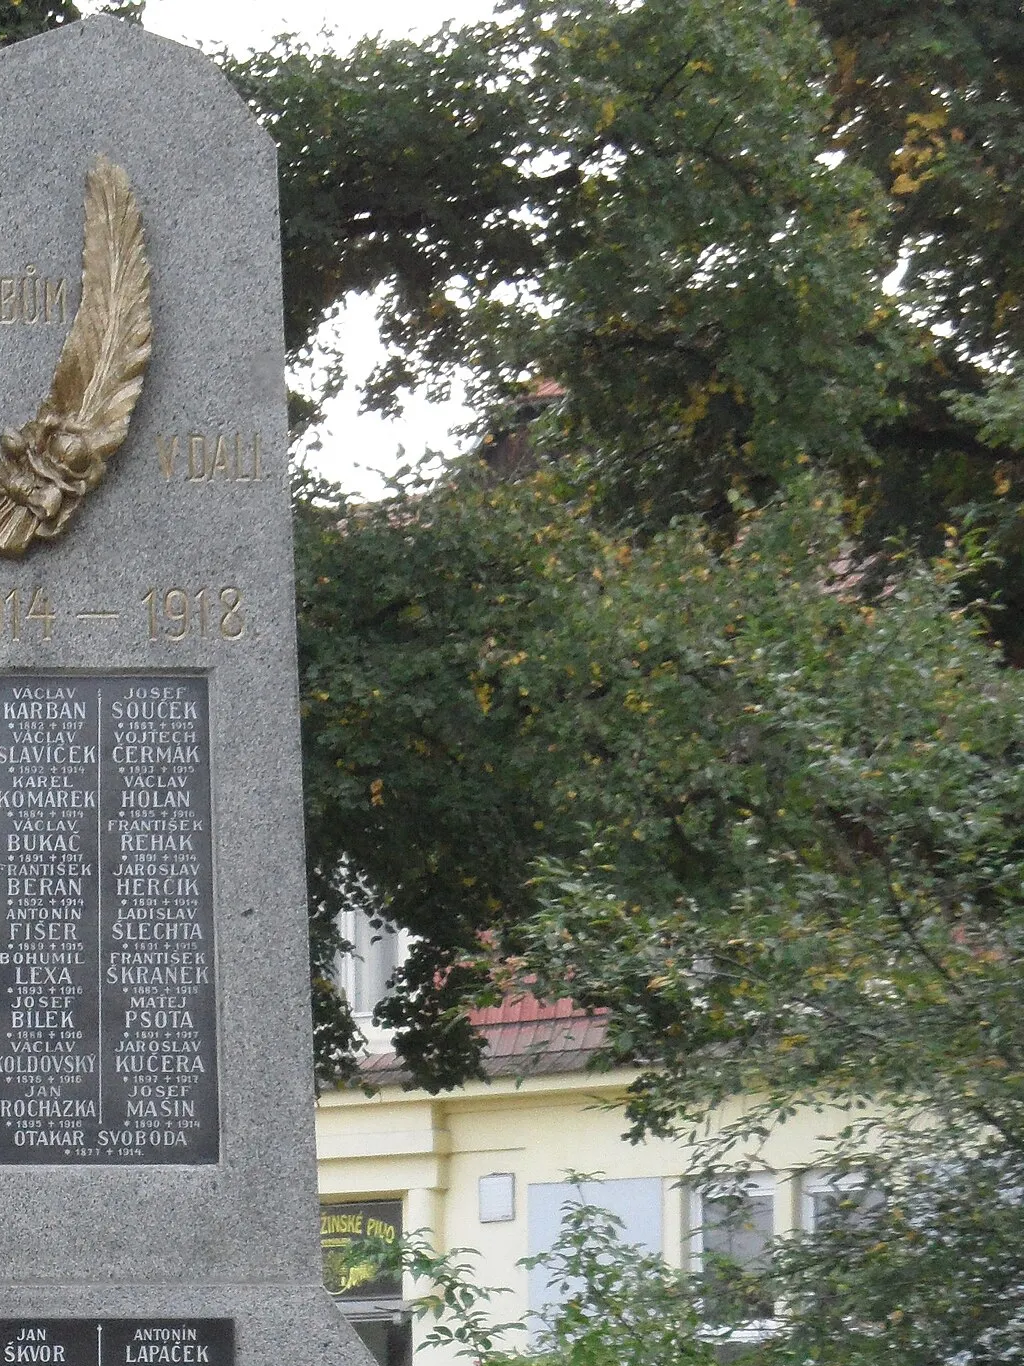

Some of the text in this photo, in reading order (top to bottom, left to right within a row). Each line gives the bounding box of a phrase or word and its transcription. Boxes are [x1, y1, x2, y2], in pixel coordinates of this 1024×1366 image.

[155, 434, 178, 482] V
[142, 587, 245, 642] 1918
[13, 686, 76, 699] VÁCLAV
[124, 687, 186, 699] JOSEF
[4, 702, 86, 719] KARBAN
[112, 699, 198, 719] SOUČEK
[12, 730, 77, 743] VÁCLAV
[112, 743, 200, 763] ČERMÁK
[13, 776, 73, 788] KAREL
[124, 773, 188, 788] VÁCLAV
[121, 790, 190, 808] HOLAN
[12, 818, 77, 831] VÁCLAV
[108, 818, 203, 831] FRANTIŠEK
[7, 830, 80, 851] BUKAČ
[121, 831, 193, 851] ŘEHÁK
[113, 864, 200, 875] JAROSLAV
[8, 878, 82, 895] BERAN
[6, 906, 82, 920] ANTONÍN
[118, 908, 198, 919] LADISLAV
[10, 920, 77, 940] FIŠER
[112, 920, 203, 940] ŠLECHTA
[0, 952, 85, 964] BOHUMIL
[111, 950, 205, 964] FRANTIŠEK
[15, 967, 72, 984] LEXA
[11, 997, 75, 1008] JOSEF
[12, 1008, 74, 1028] BÍLEK
[125, 1011, 194, 1028] PSOTA
[11, 1039, 76, 1052] VÁCLAV
[115, 1041, 201, 1052] JAROSLAV
[115, 1053, 205, 1072] KUČERA
[25, 1086, 62, 1097] JAN
[128, 1085, 191, 1097] JOSEF
[14, 1131, 187, 1146] OTAKAR SVOBODA
[16, 1329, 46, 1341] JAN
[134, 1325, 197, 1341] ANTONÍN
[4, 1342, 66, 1362] ŠKVOR
[126, 1340, 209, 1363] LAPÁČEK
